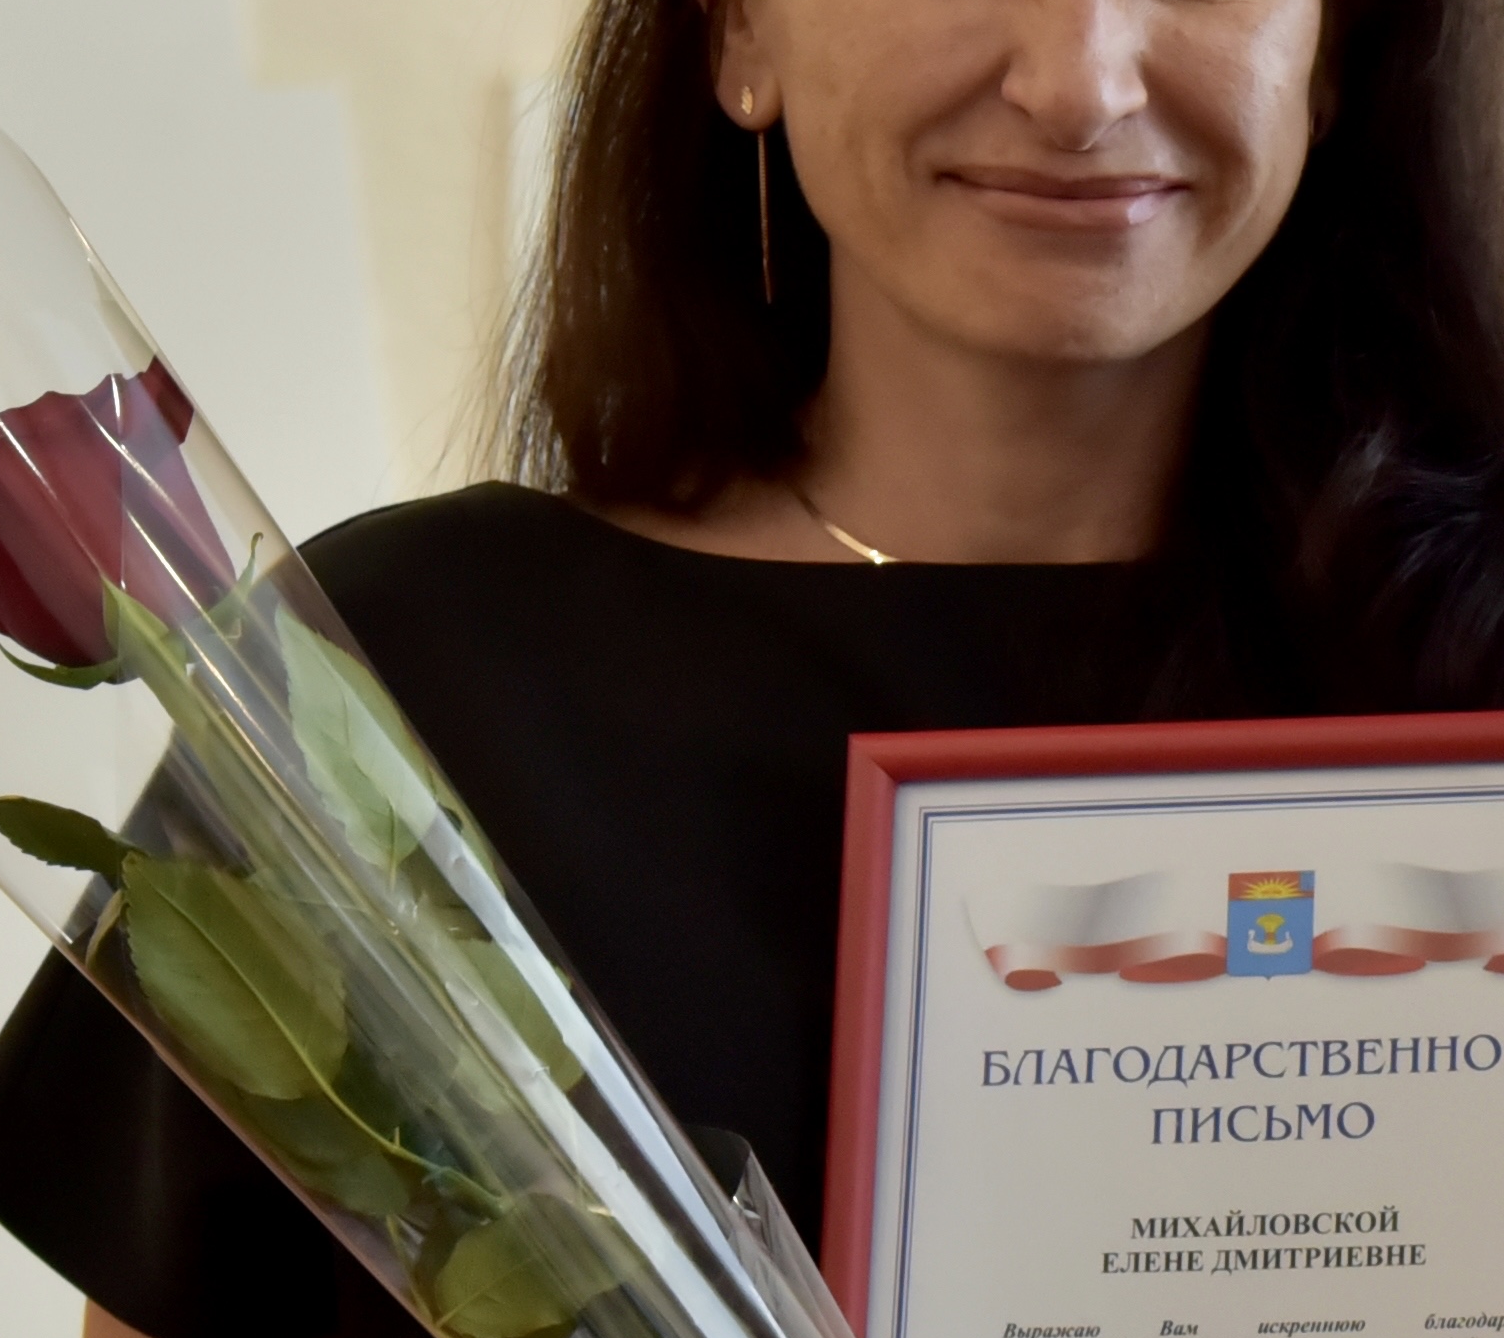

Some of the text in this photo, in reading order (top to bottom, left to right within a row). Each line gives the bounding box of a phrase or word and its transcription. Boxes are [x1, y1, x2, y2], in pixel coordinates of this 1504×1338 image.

[1151, 1101, 1376, 1145] ПИСЬМО
[1131, 1205, 1399, 1239] МИХАЙЛОВСКОЙ
[1102, 1244, 1427, 1275] ЕЛЕНЕ ДМИТРИЕВНЕ
[1159, 1319, 1199, 1337] Вам
[1257, 1319, 1367, 1338] искреннюю
